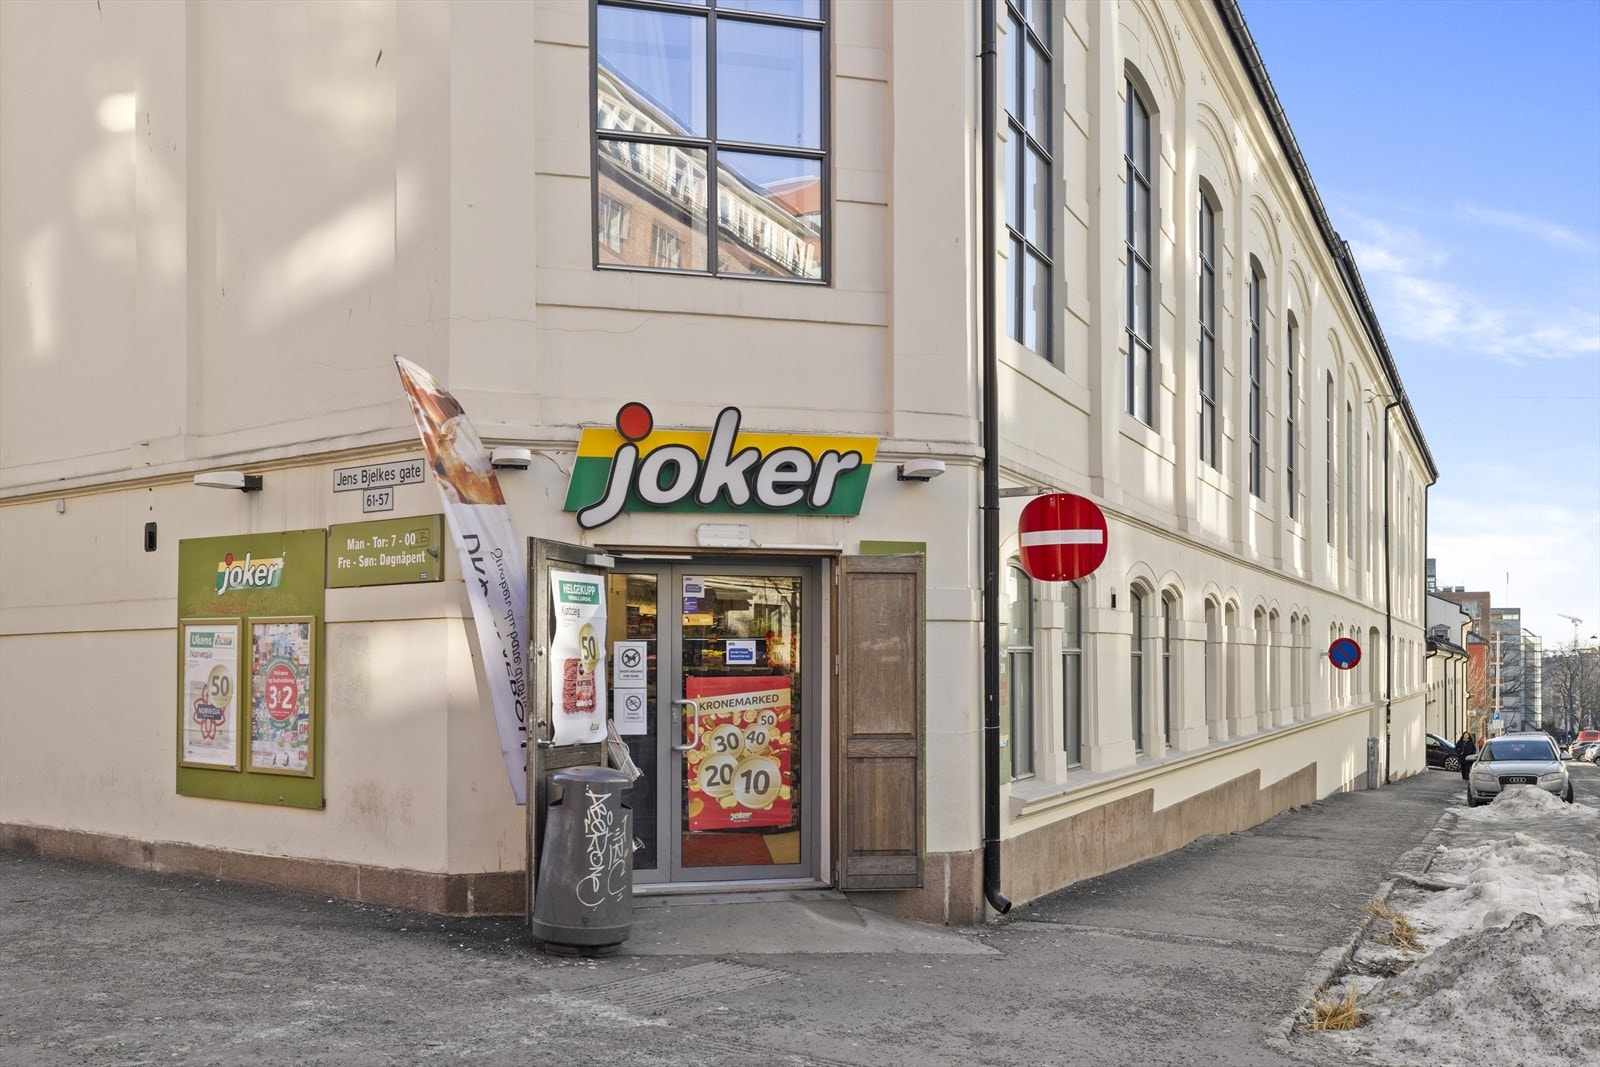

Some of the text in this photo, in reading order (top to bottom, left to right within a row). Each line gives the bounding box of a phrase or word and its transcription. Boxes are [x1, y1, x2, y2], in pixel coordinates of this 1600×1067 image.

[576, 401, 863, 530] joker
[337, 465, 421, 487] Jens Bjelkes gate
[366, 492, 390, 507] 61-57
[347, 538, 365, 551] Man
[372, 535, 389, 548] Tor:
[391, 534, 397, 547] 7
[404, 532, 416, 546] 00
[338, 556, 351, 569] Fre
[358, 555, 377, 567] Søn:
[379, 550, 426, 567] Døgnåpent
[216, 551, 281, 596] joker
[562, 583, 596, 596] HELGEKUPP
[191, 634, 213, 646] Ukens
[581, 636, 596, 660] 50
[189, 649, 213, 660] Norvegia
[211, 675, 230, 697] 50
[268, 685, 278, 709] 3
[281, 685, 293, 709] 2
[699, 694, 780, 711] KRONEMARKED
[760, 715, 775, 726] 50
[713, 730, 766, 753] 30 40
[704, 763, 771, 796] 20 10
